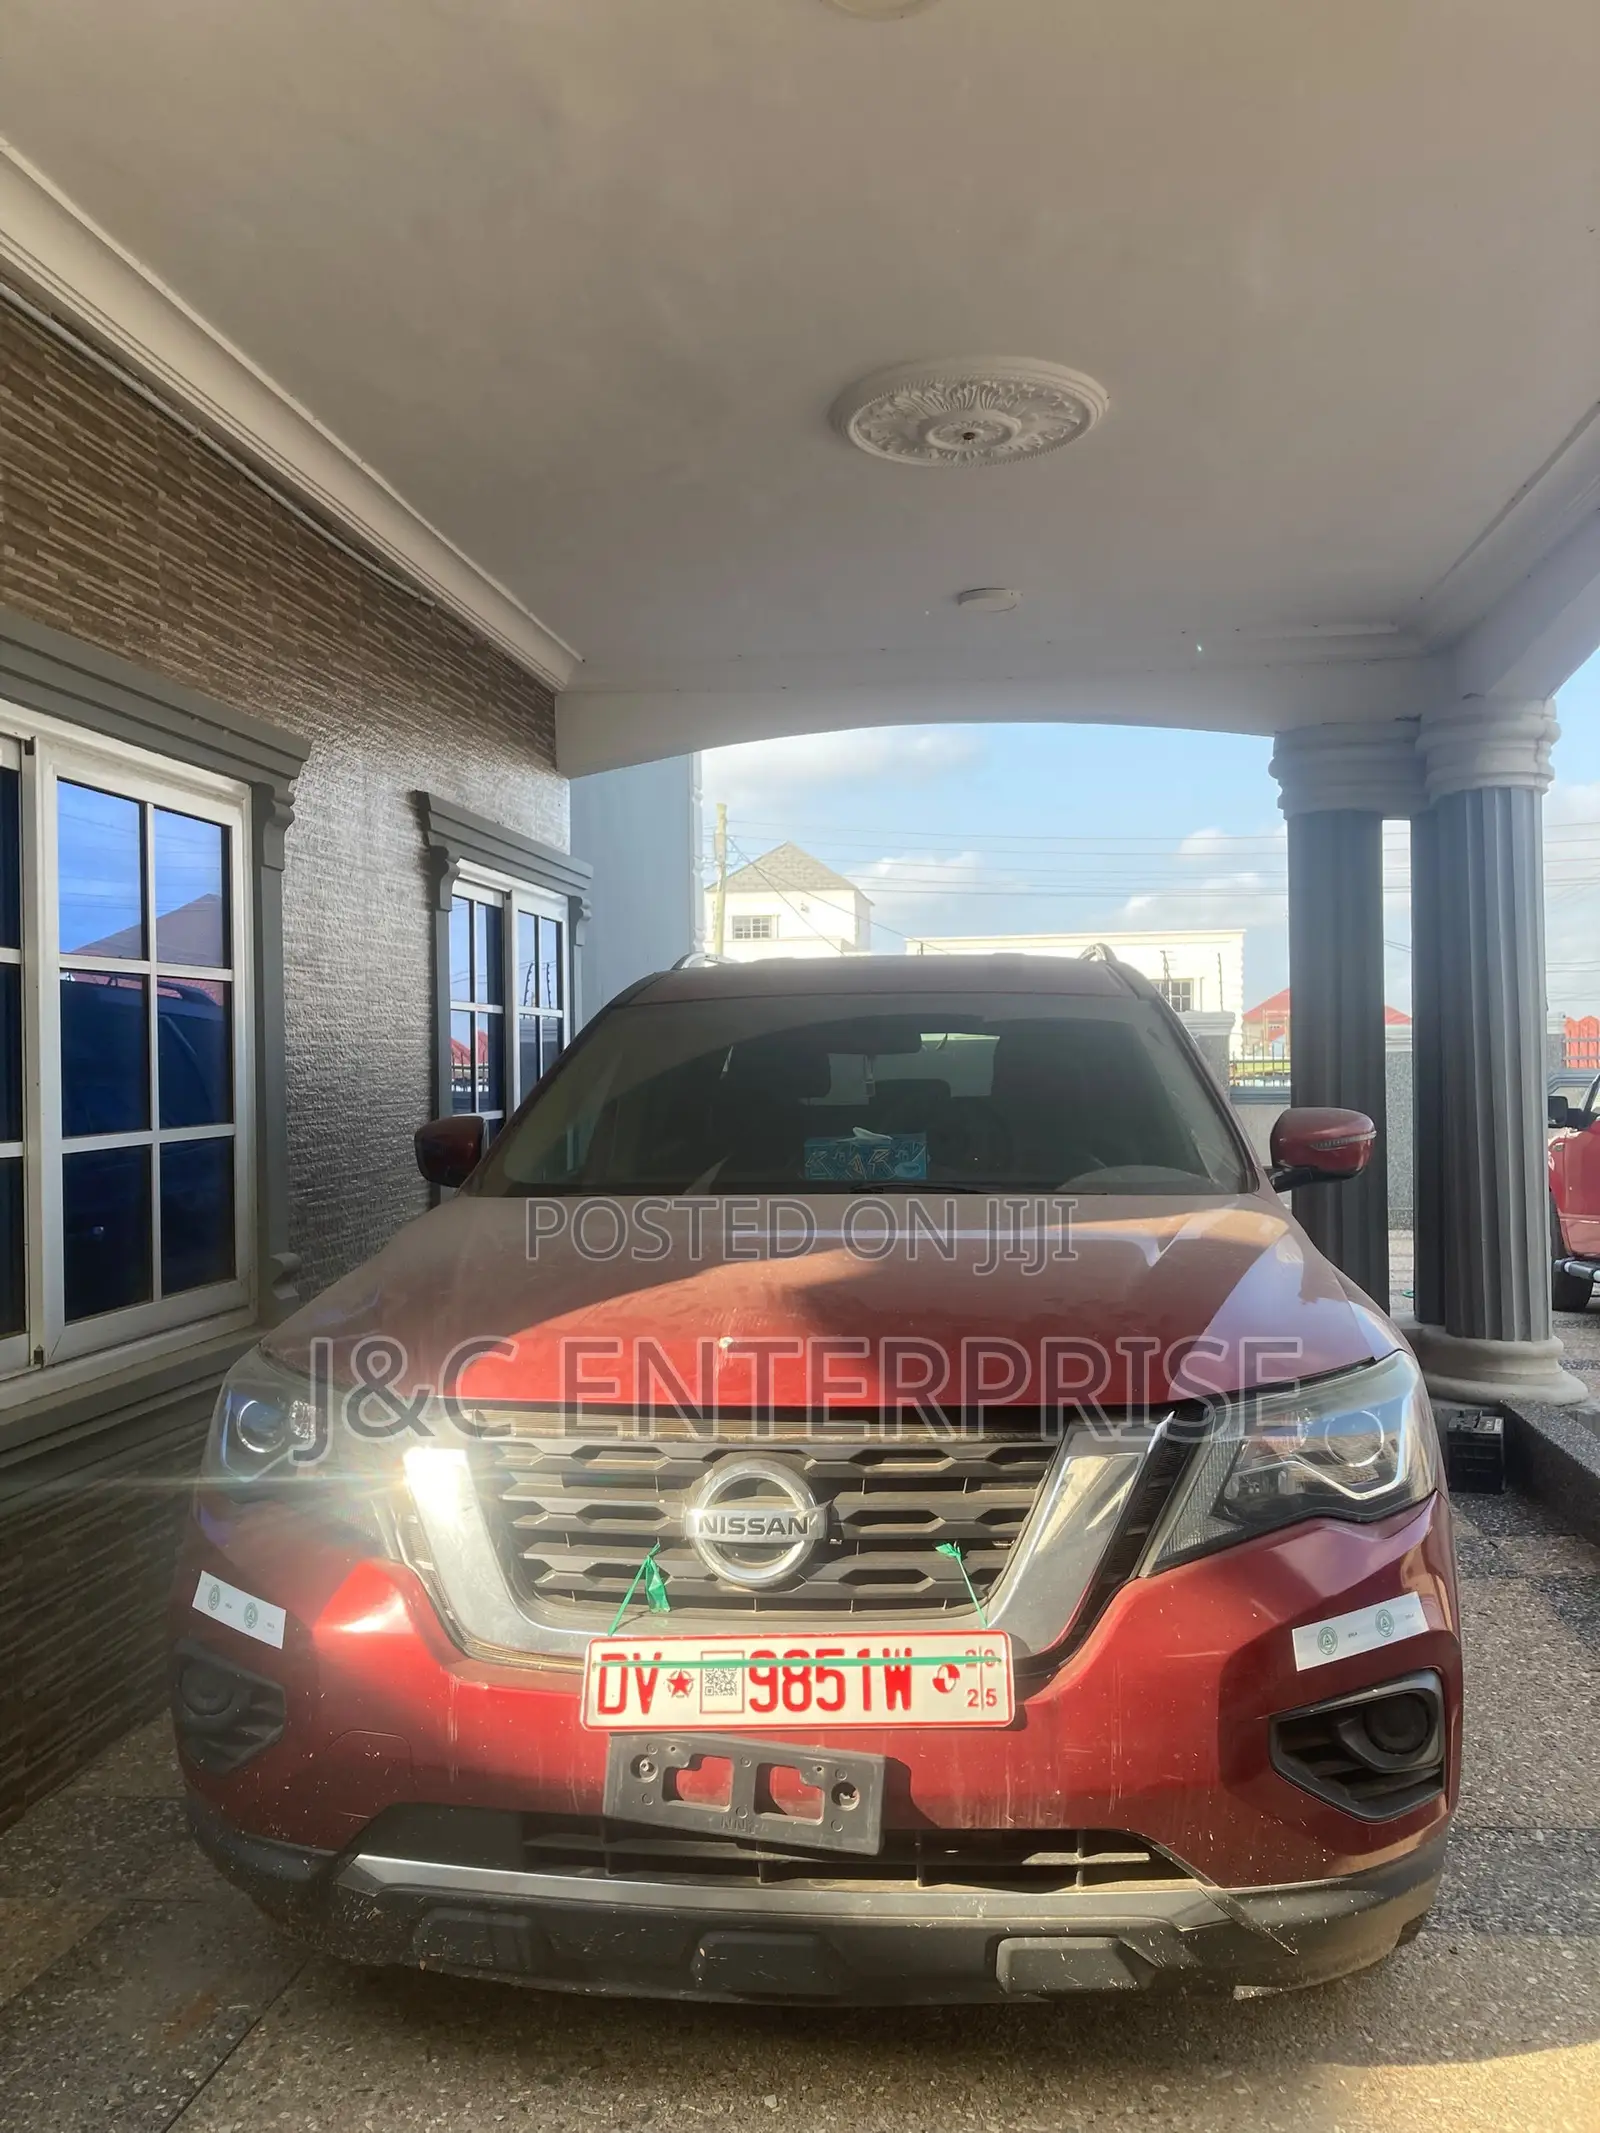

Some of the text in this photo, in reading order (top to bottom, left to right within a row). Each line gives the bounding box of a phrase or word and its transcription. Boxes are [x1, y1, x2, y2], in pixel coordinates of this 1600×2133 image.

[699, 1516, 809, 1536] NISSAN
[597, 1651, 663, 1716] DV
[966, 1687, 998, 1708] 25
